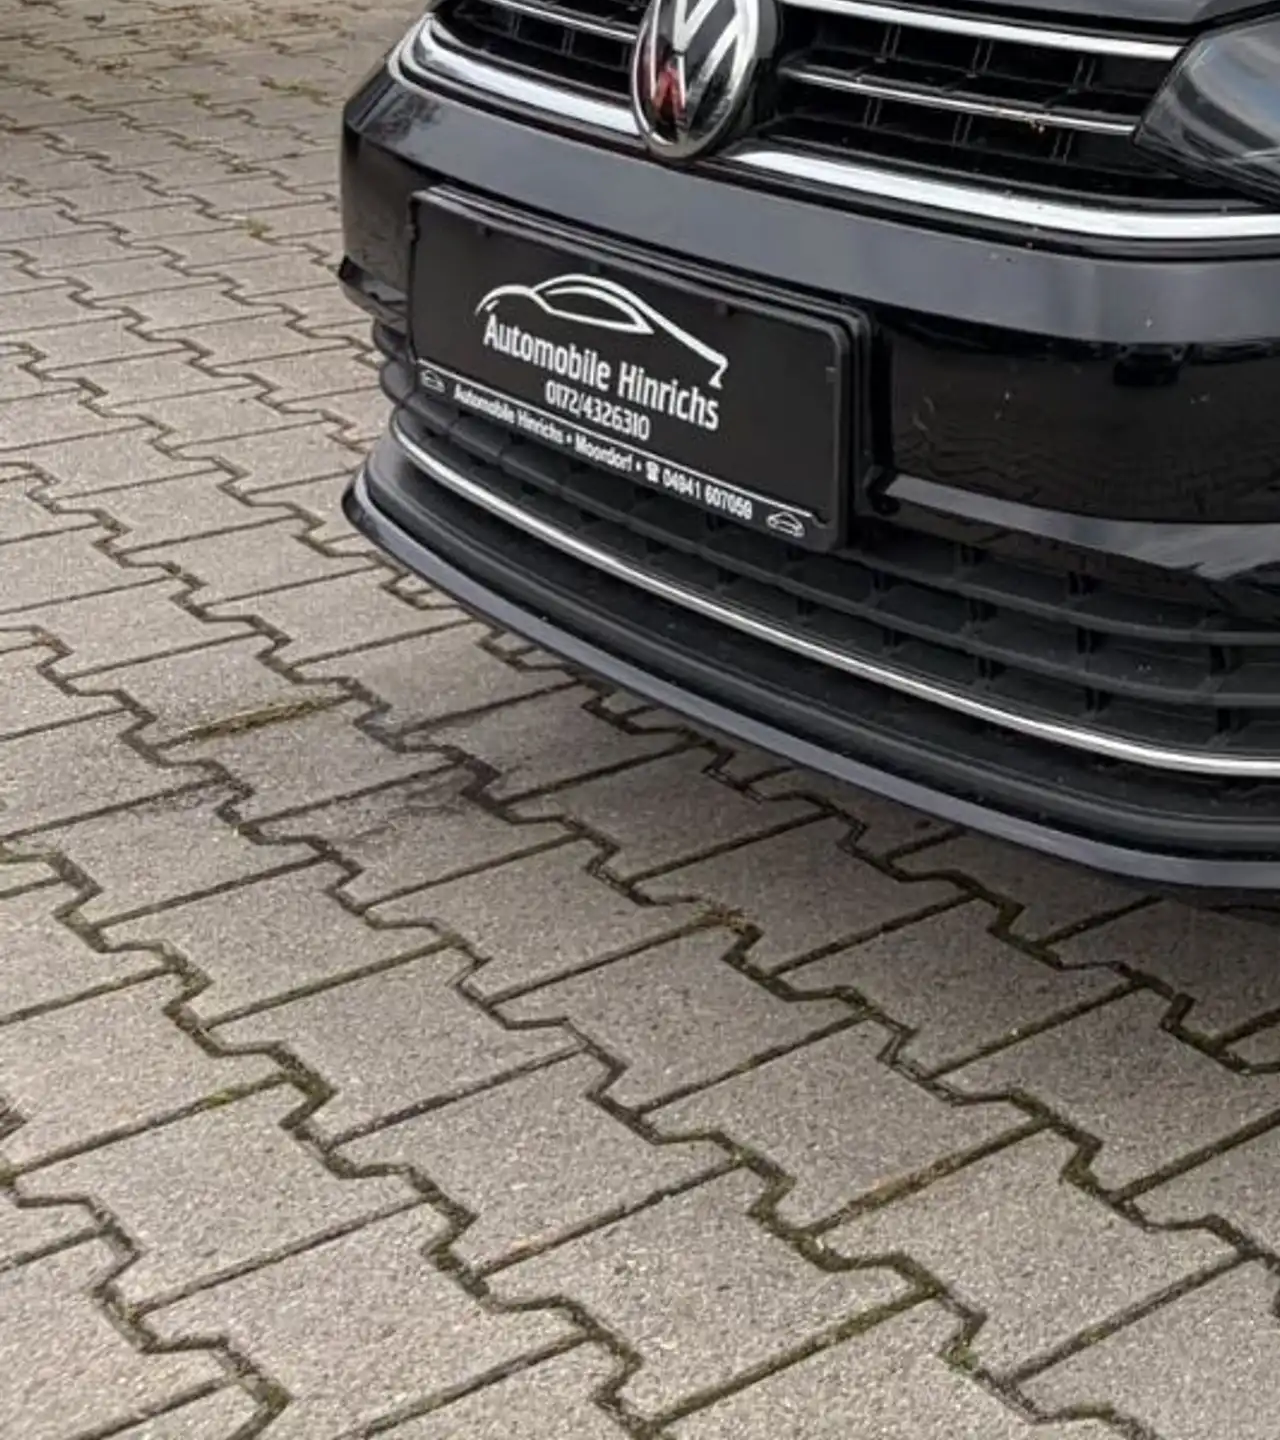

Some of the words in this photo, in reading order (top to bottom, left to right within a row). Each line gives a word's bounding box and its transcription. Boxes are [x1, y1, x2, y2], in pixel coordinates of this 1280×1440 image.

[483, 313, 611, 392] Automobile
[617, 361, 720, 431] Hinrichs
[545, 379, 651, 442] 0172/4326310
